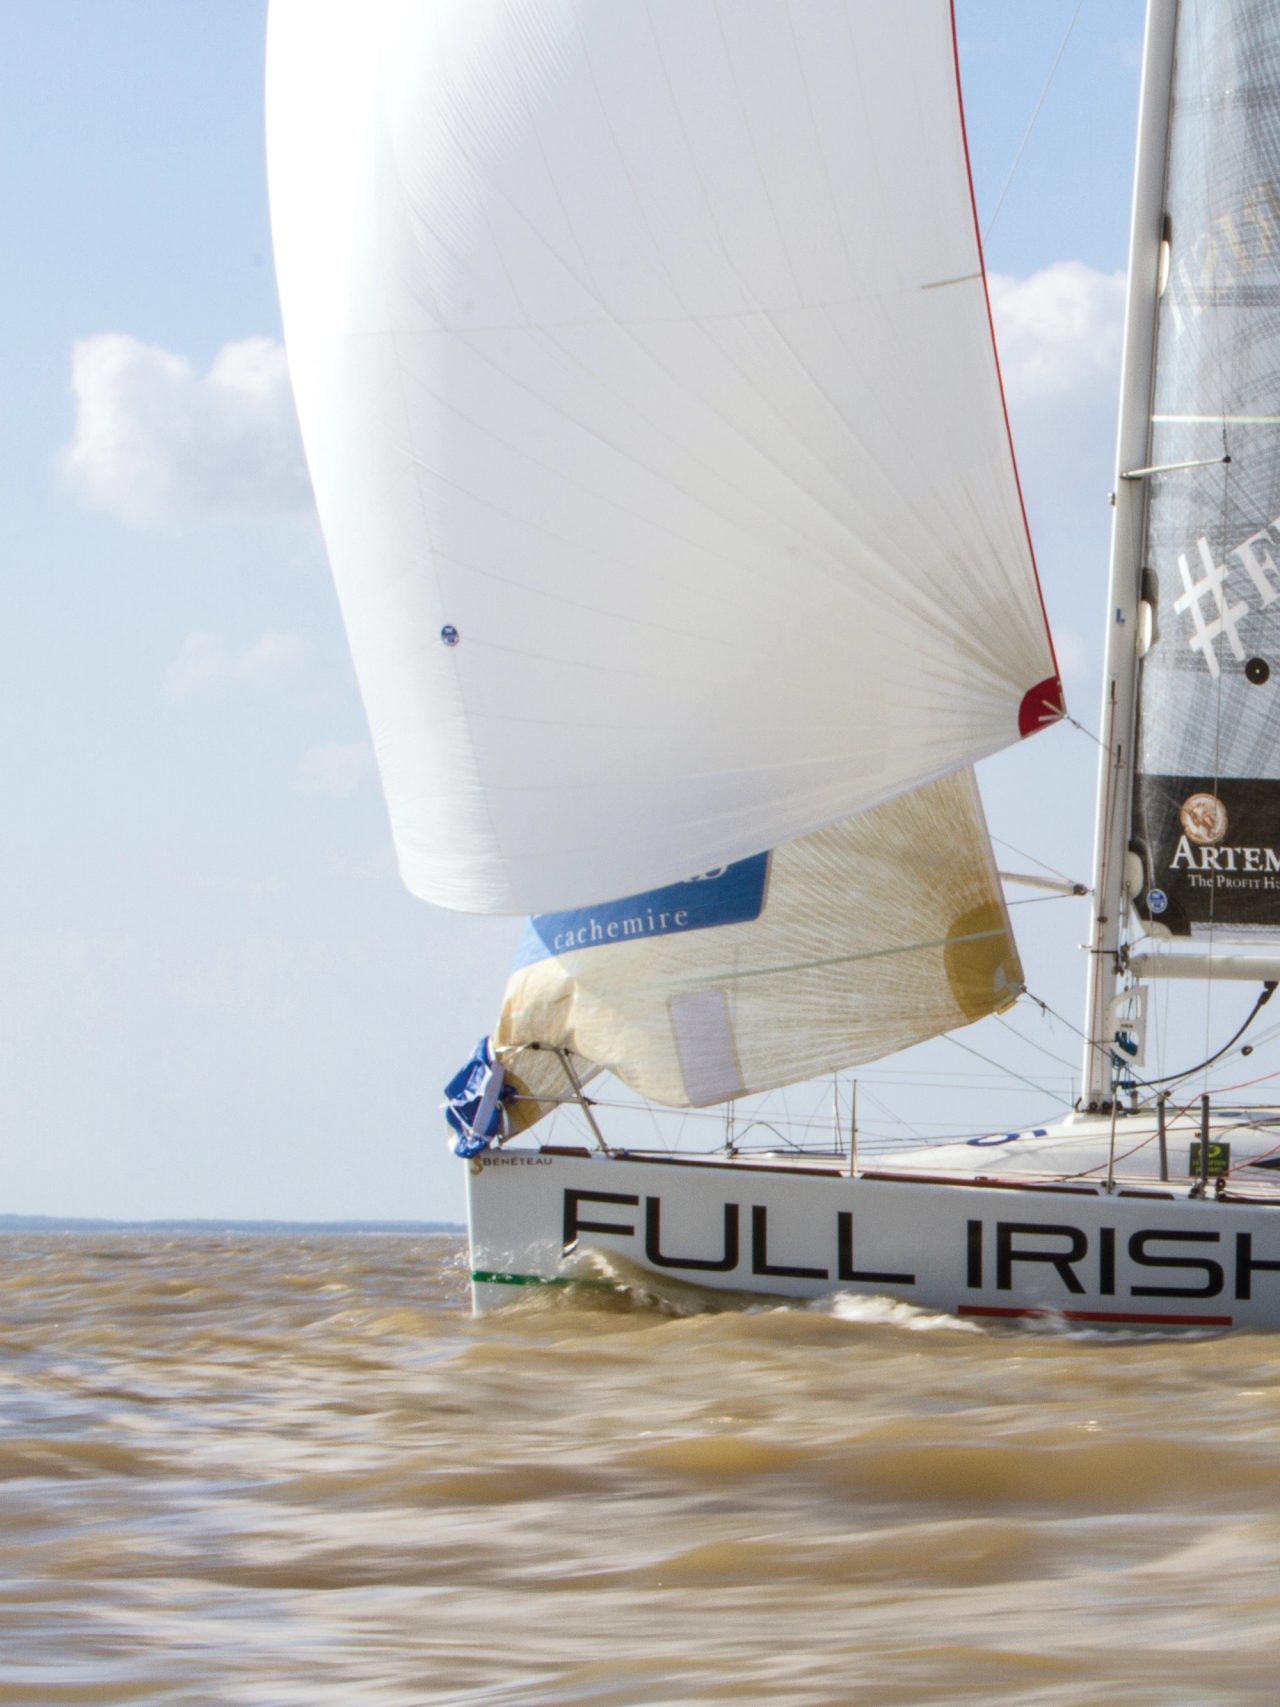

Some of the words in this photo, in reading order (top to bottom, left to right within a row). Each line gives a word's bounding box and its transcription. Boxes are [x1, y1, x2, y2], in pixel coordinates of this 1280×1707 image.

[1188, 874, 1214, 888] The
[1216, 875, 1261, 889] PROFIT
[553, 908, 689, 950] cachemire
[562, 1188, 916, 1286] FULL
